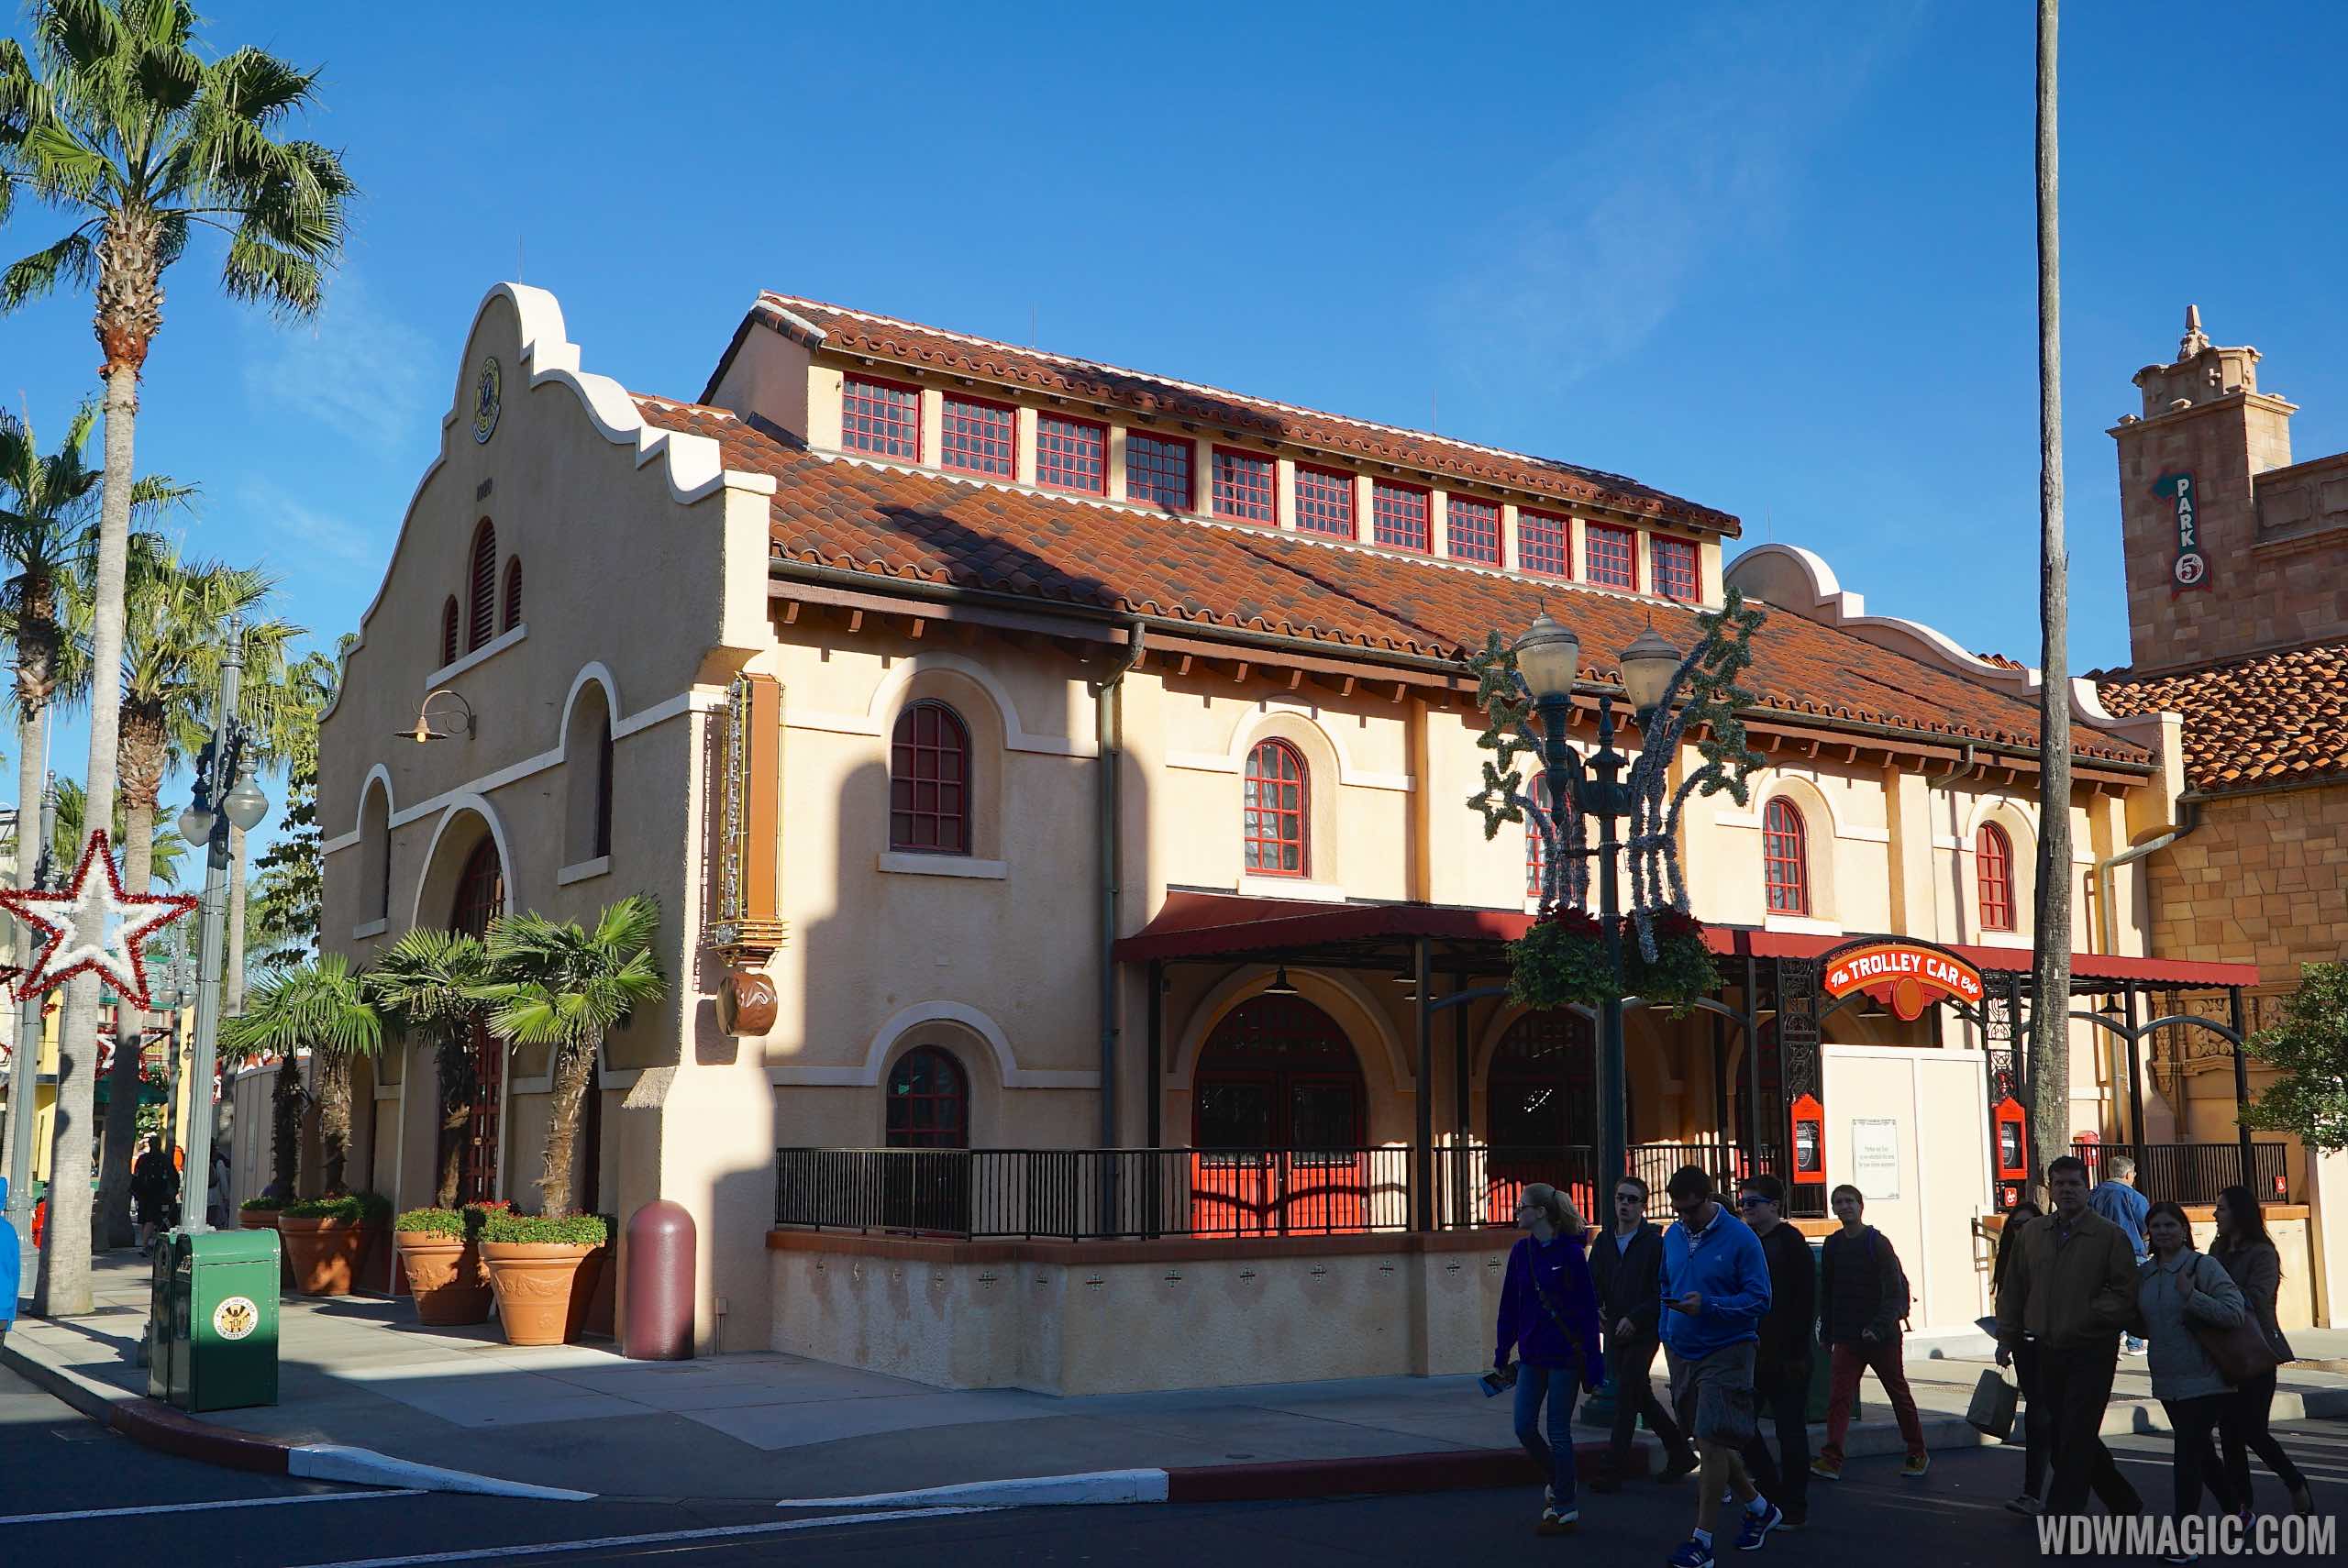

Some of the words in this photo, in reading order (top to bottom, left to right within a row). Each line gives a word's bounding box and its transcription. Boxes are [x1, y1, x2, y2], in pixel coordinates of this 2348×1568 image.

[2176, 478, 2195, 547] PARK
[1831, 969, 1849, 988] The
[1847, 953, 1922, 980] TROLLEY
[1926, 957, 1959, 987] CAR
[240, 1321, 255, 1336] CLEAN
